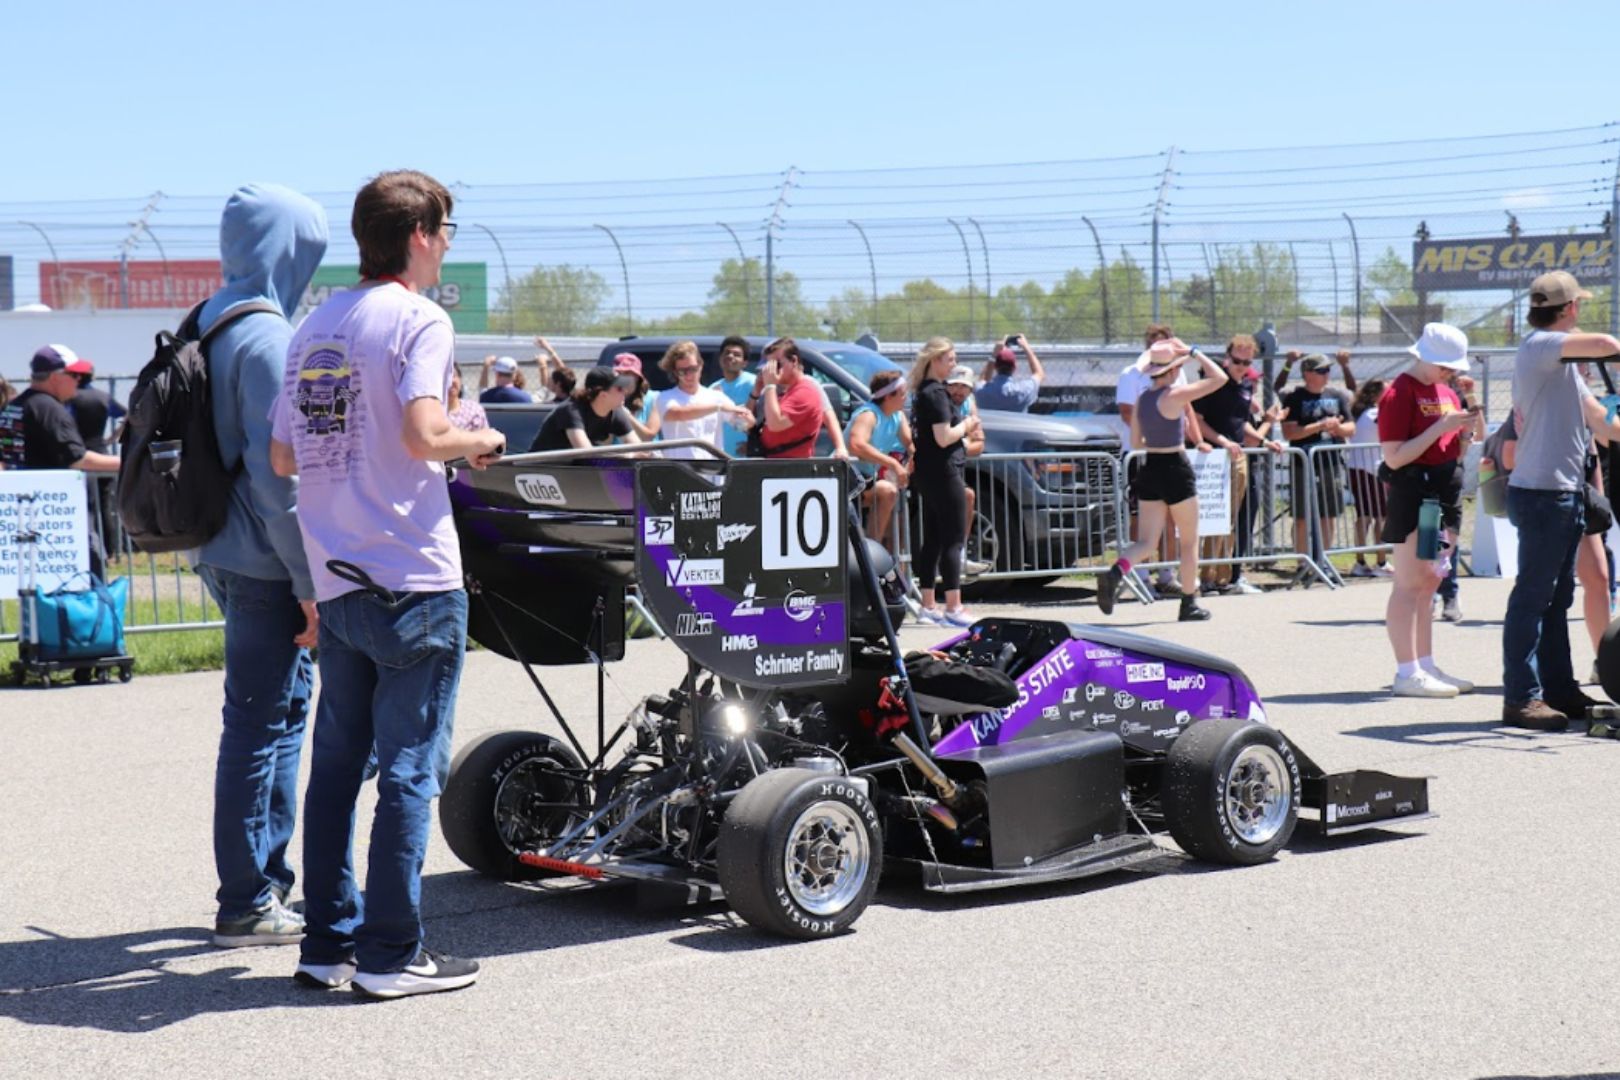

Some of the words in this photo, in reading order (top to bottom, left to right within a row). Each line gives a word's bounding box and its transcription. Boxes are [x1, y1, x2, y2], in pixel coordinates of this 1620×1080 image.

[1416, 244, 1495, 272] MIS
[518, 479, 561, 500] Tube
[42, 504, 76, 516] Clear
[0, 520, 73, 533] Spcators
[771, 489, 830, 557] 10
[45, 533, 75, 545] Cars
[684, 568, 721, 581] VEKTEK
[789, 595, 817, 607] BMG
[754, 653, 804, 676] Schriner
[805, 648, 845, 675] Family
[1028, 647, 1076, 695] STATE
